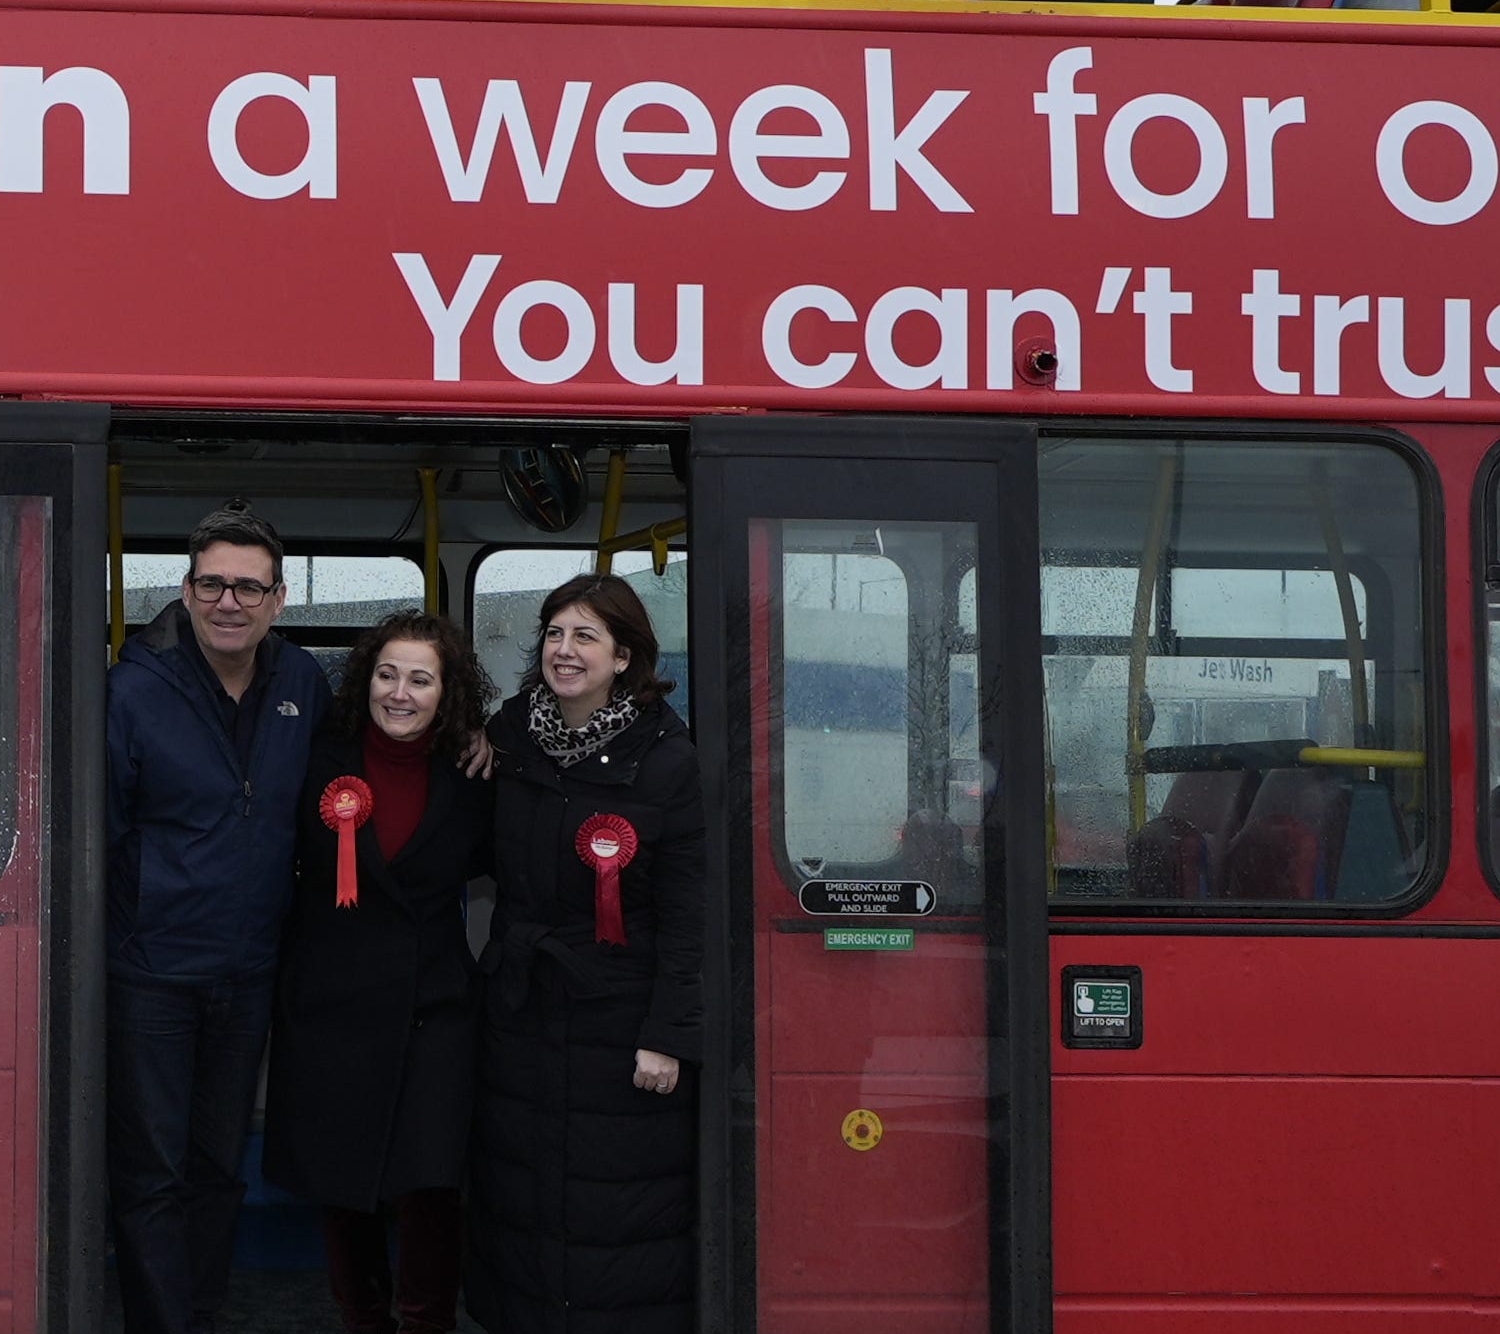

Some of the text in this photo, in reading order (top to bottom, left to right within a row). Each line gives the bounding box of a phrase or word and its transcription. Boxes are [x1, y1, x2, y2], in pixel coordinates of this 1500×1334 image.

[207, 71, 338, 200] a
[412, 48, 975, 213] week
[1033, 47, 1307, 219] for
[392, 252, 705, 385] You
[762, 267, 1194, 393] can't
[1229, 658, 1273, 684] Wash
[825, 883, 903, 893] EMERGENCY EXIT
[828, 893, 901, 903] PULL OUTWARD
[840, 905, 889, 914] AND SLIDE
[827, 933, 911, 946] EMERGENCY EXIT
